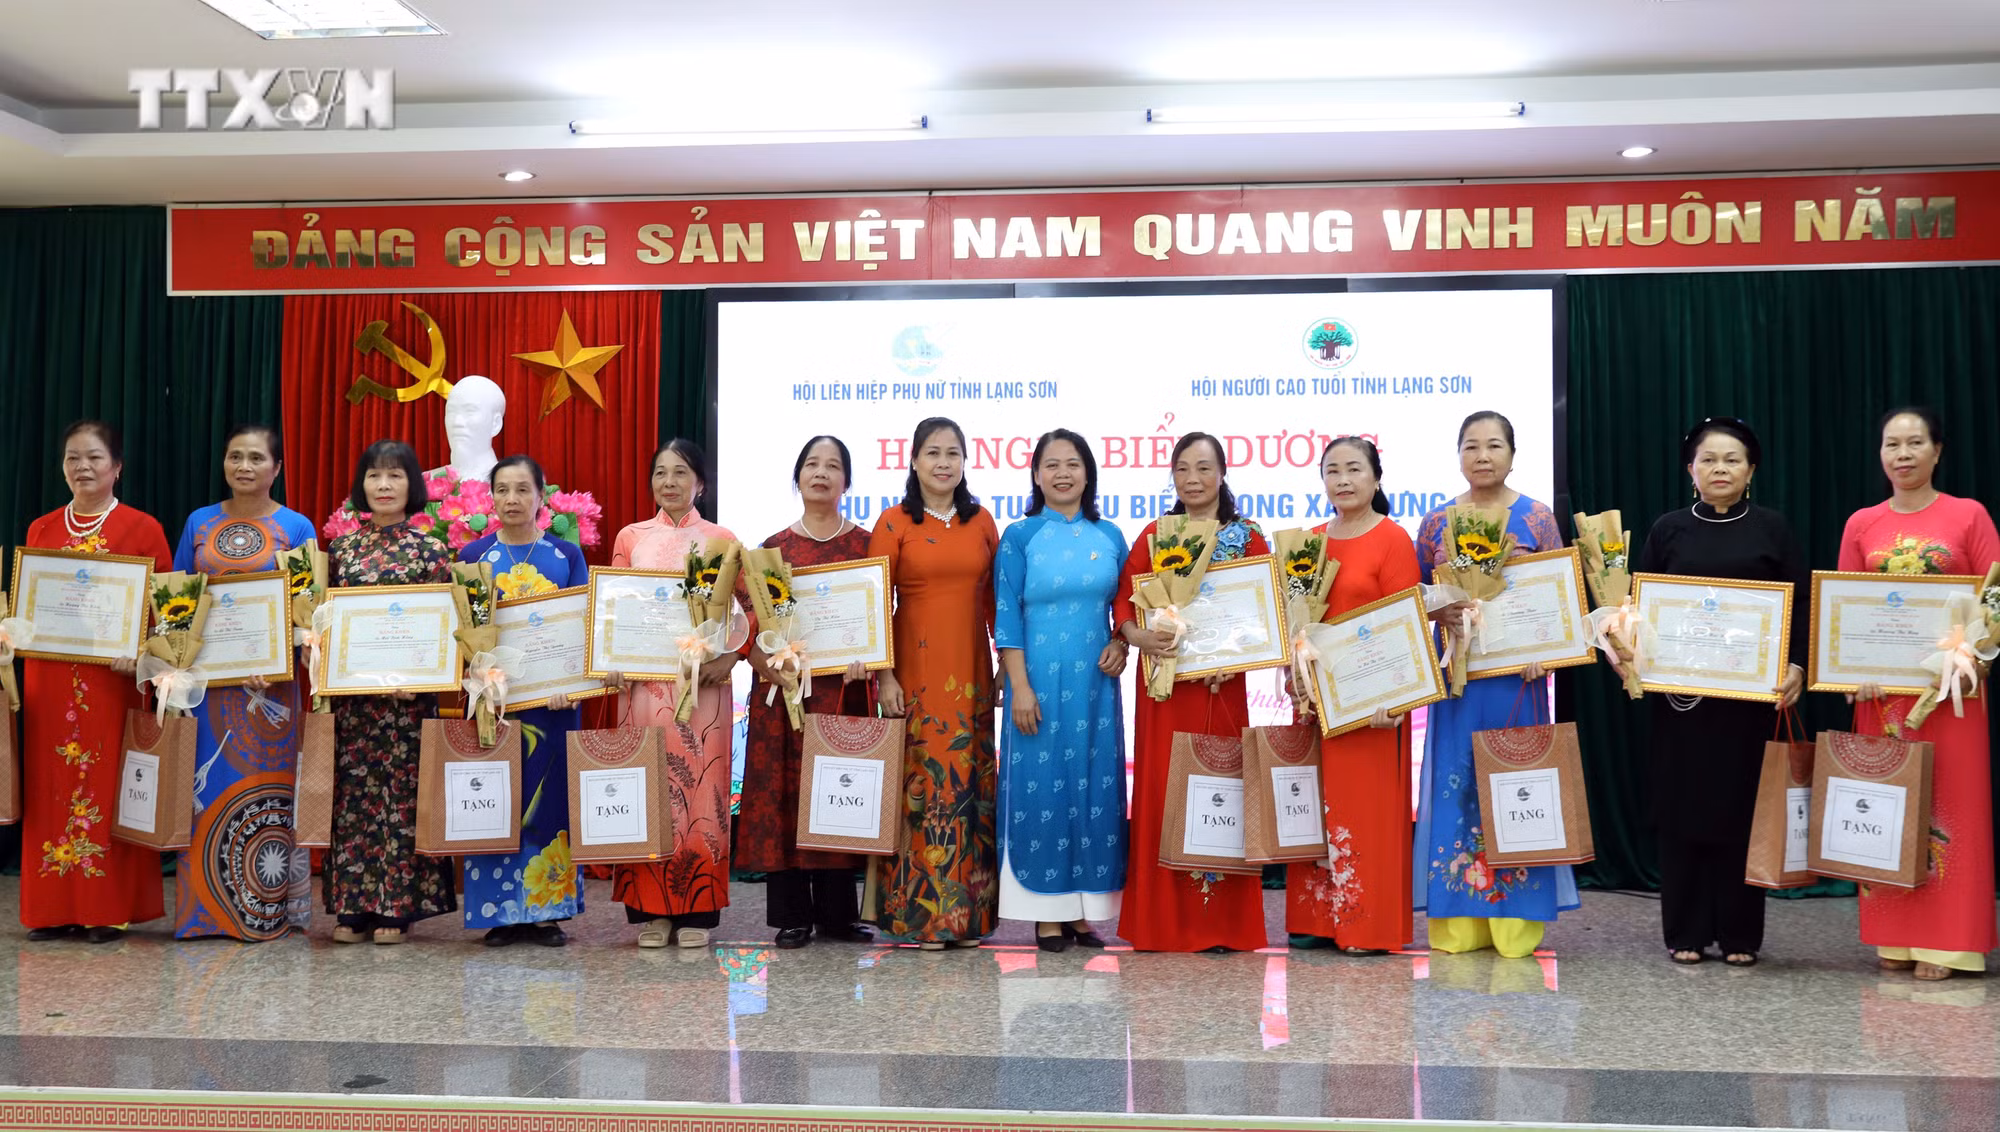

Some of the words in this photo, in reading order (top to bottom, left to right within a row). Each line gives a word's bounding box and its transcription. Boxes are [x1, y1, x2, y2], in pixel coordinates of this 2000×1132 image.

[250, 213, 416, 269] ĐẢNG
[443, 216, 607, 276] CỘNG
[636, 206, 765, 265] SẢN
[793, 209, 925, 271] VIỆT
[953, 215, 1101, 259] NAM
[1133, 210, 1354, 261] QUANG
[1382, 207, 1534, 251] VINH
[1566, 191, 1762, 247] MUÔN
[1794, 186, 1956, 242] NĂM
[793, 379, 816, 405] HỘI
[821, 379, 851, 401] LIÊN
[856, 379, 888, 404] HIỆP
[893, 383, 921, 404] PHỤ
[987, 381, 1023, 403] LẠNG
[1029, 380, 1057, 399] SƠN
[1191, 375, 1216, 401] HỘI
[1222, 374, 1270, 396] NGƯỜI
[1276, 378, 1306, 396] CAO
[1393, 376, 1433, 398] LẠNG
[1440, 375, 1472, 394] SƠN
[1101, 412, 1176, 468] BIỂ
[837, 496, 870, 526] HỤ
[1130, 484, 1176, 519] BIỂ
[1238, 494, 1294, 518] ONG
[461, 799, 496, 812] TẠNG
[828, 794, 864, 808] TẠNG
[596, 804, 629, 818] TẠNG
[1286, 804, 1310, 817] TẠNG
[1509, 809, 1545, 823] TẠNG
[1202, 814, 1236, 827] TẠNG
[1842, 819, 1882, 836] TẠNG
